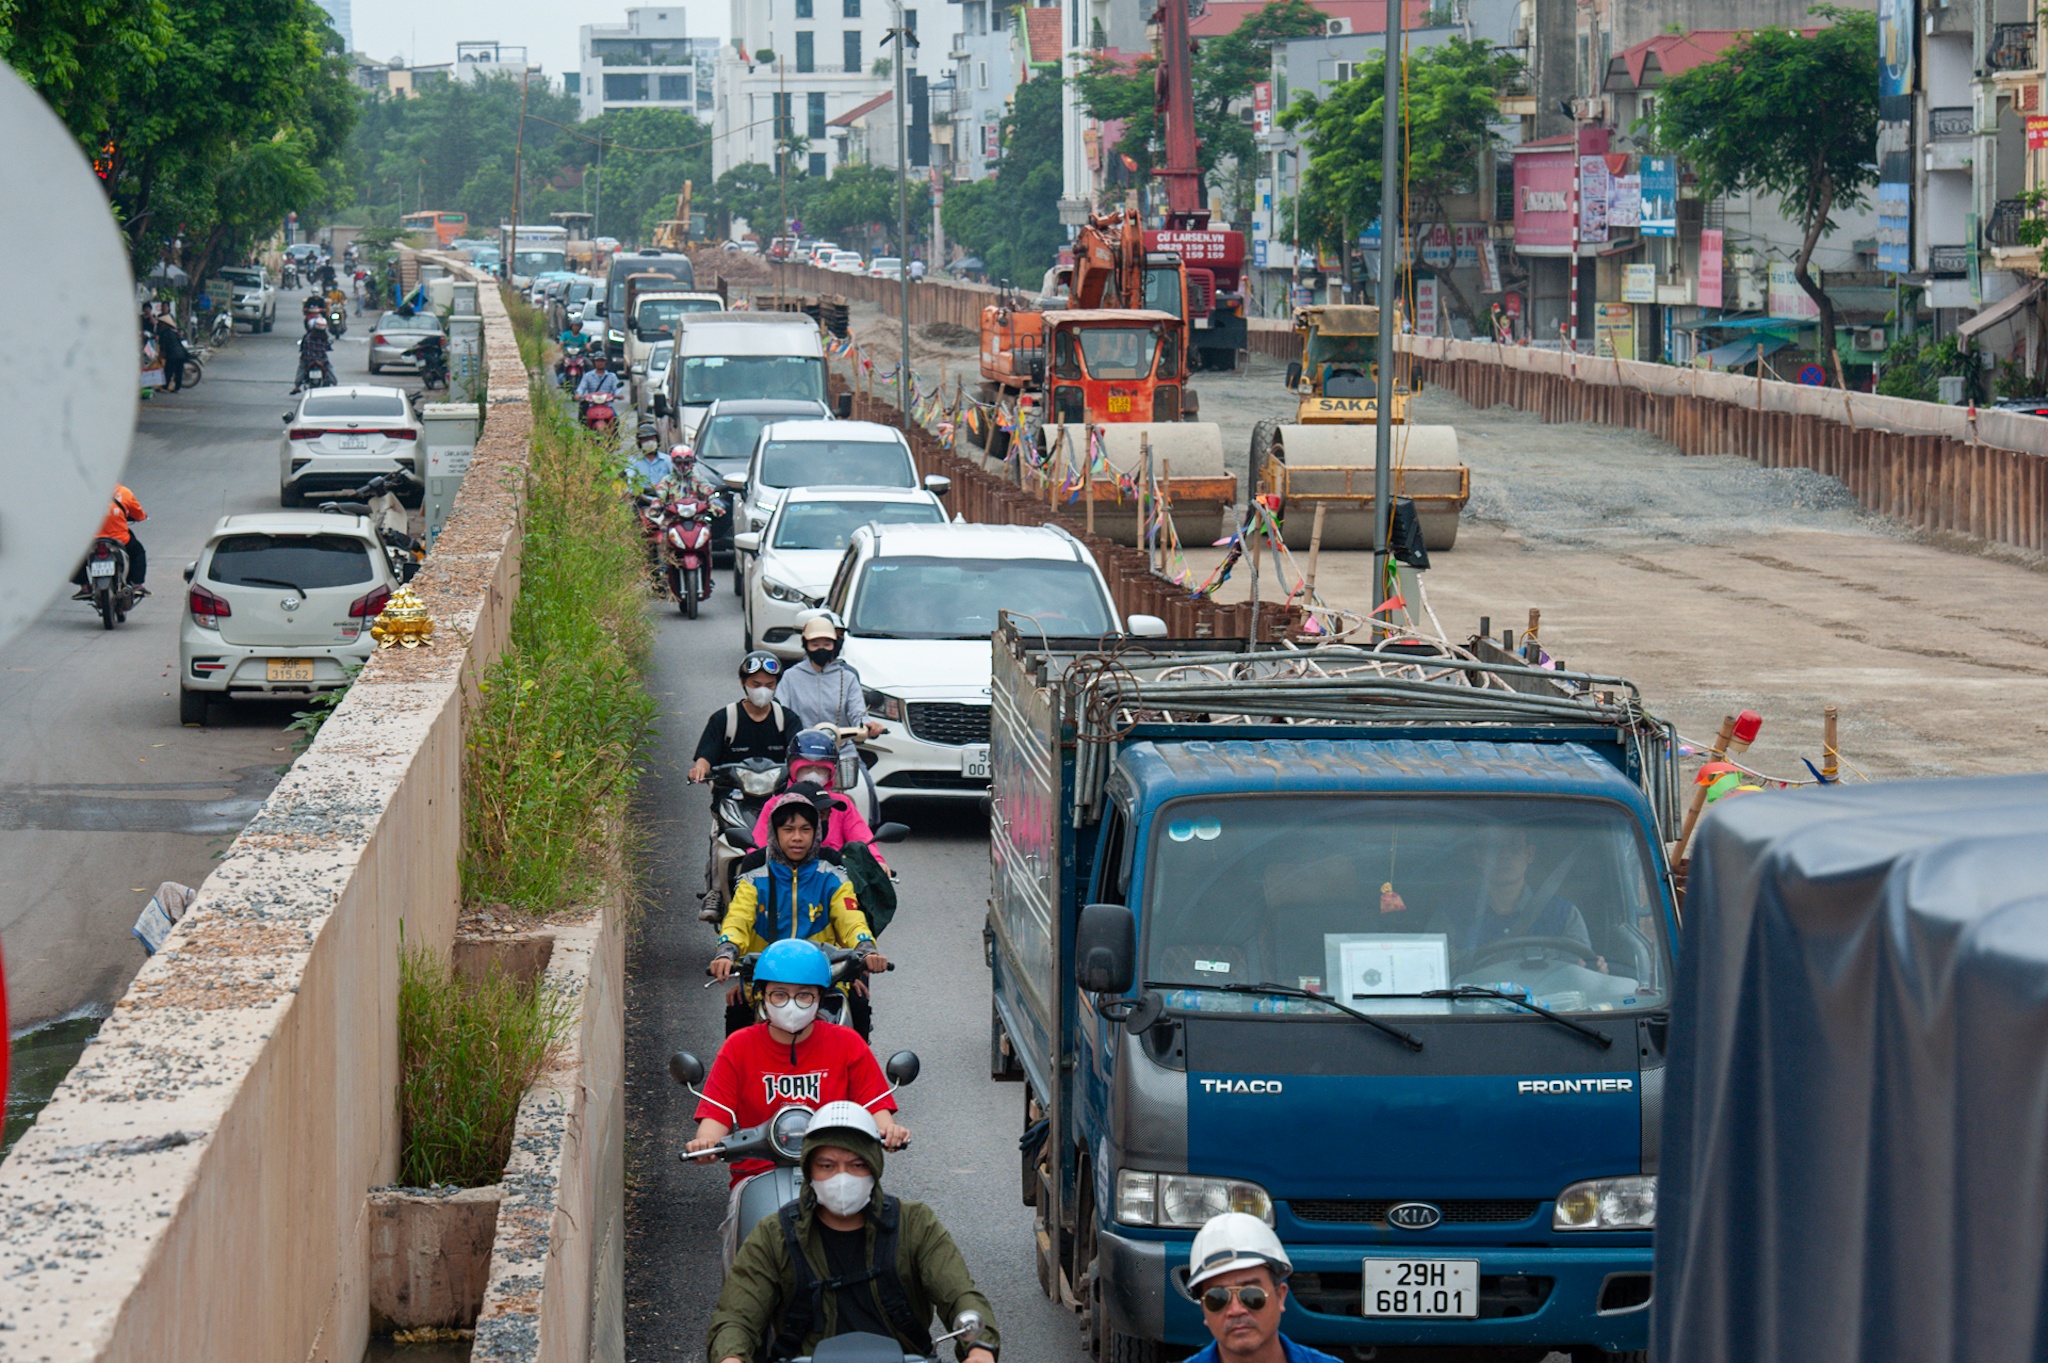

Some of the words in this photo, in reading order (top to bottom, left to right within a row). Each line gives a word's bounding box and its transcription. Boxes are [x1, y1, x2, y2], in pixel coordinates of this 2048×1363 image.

[1173, 233, 1225, 243] LARSEN.VN
[1186, 243, 1204, 252] 159
[1207, 243, 1225, 252] 159
[1186, 251, 1204, 259] 159
[1207, 251, 1225, 259] 159
[1319, 400, 1378, 411] SAKA
[280, 660, 300, 669] 30F
[272, 670, 309, 680] 315.62
[1200, 1079, 1282, 1094] THACO
[1518, 1079, 1633, 1095] FRONTIER
[1398, 1209, 1432, 1222] KIA
[1397, 1263, 1445, 1286] 29H
[1377, 1290, 1462, 1313] 681.01
